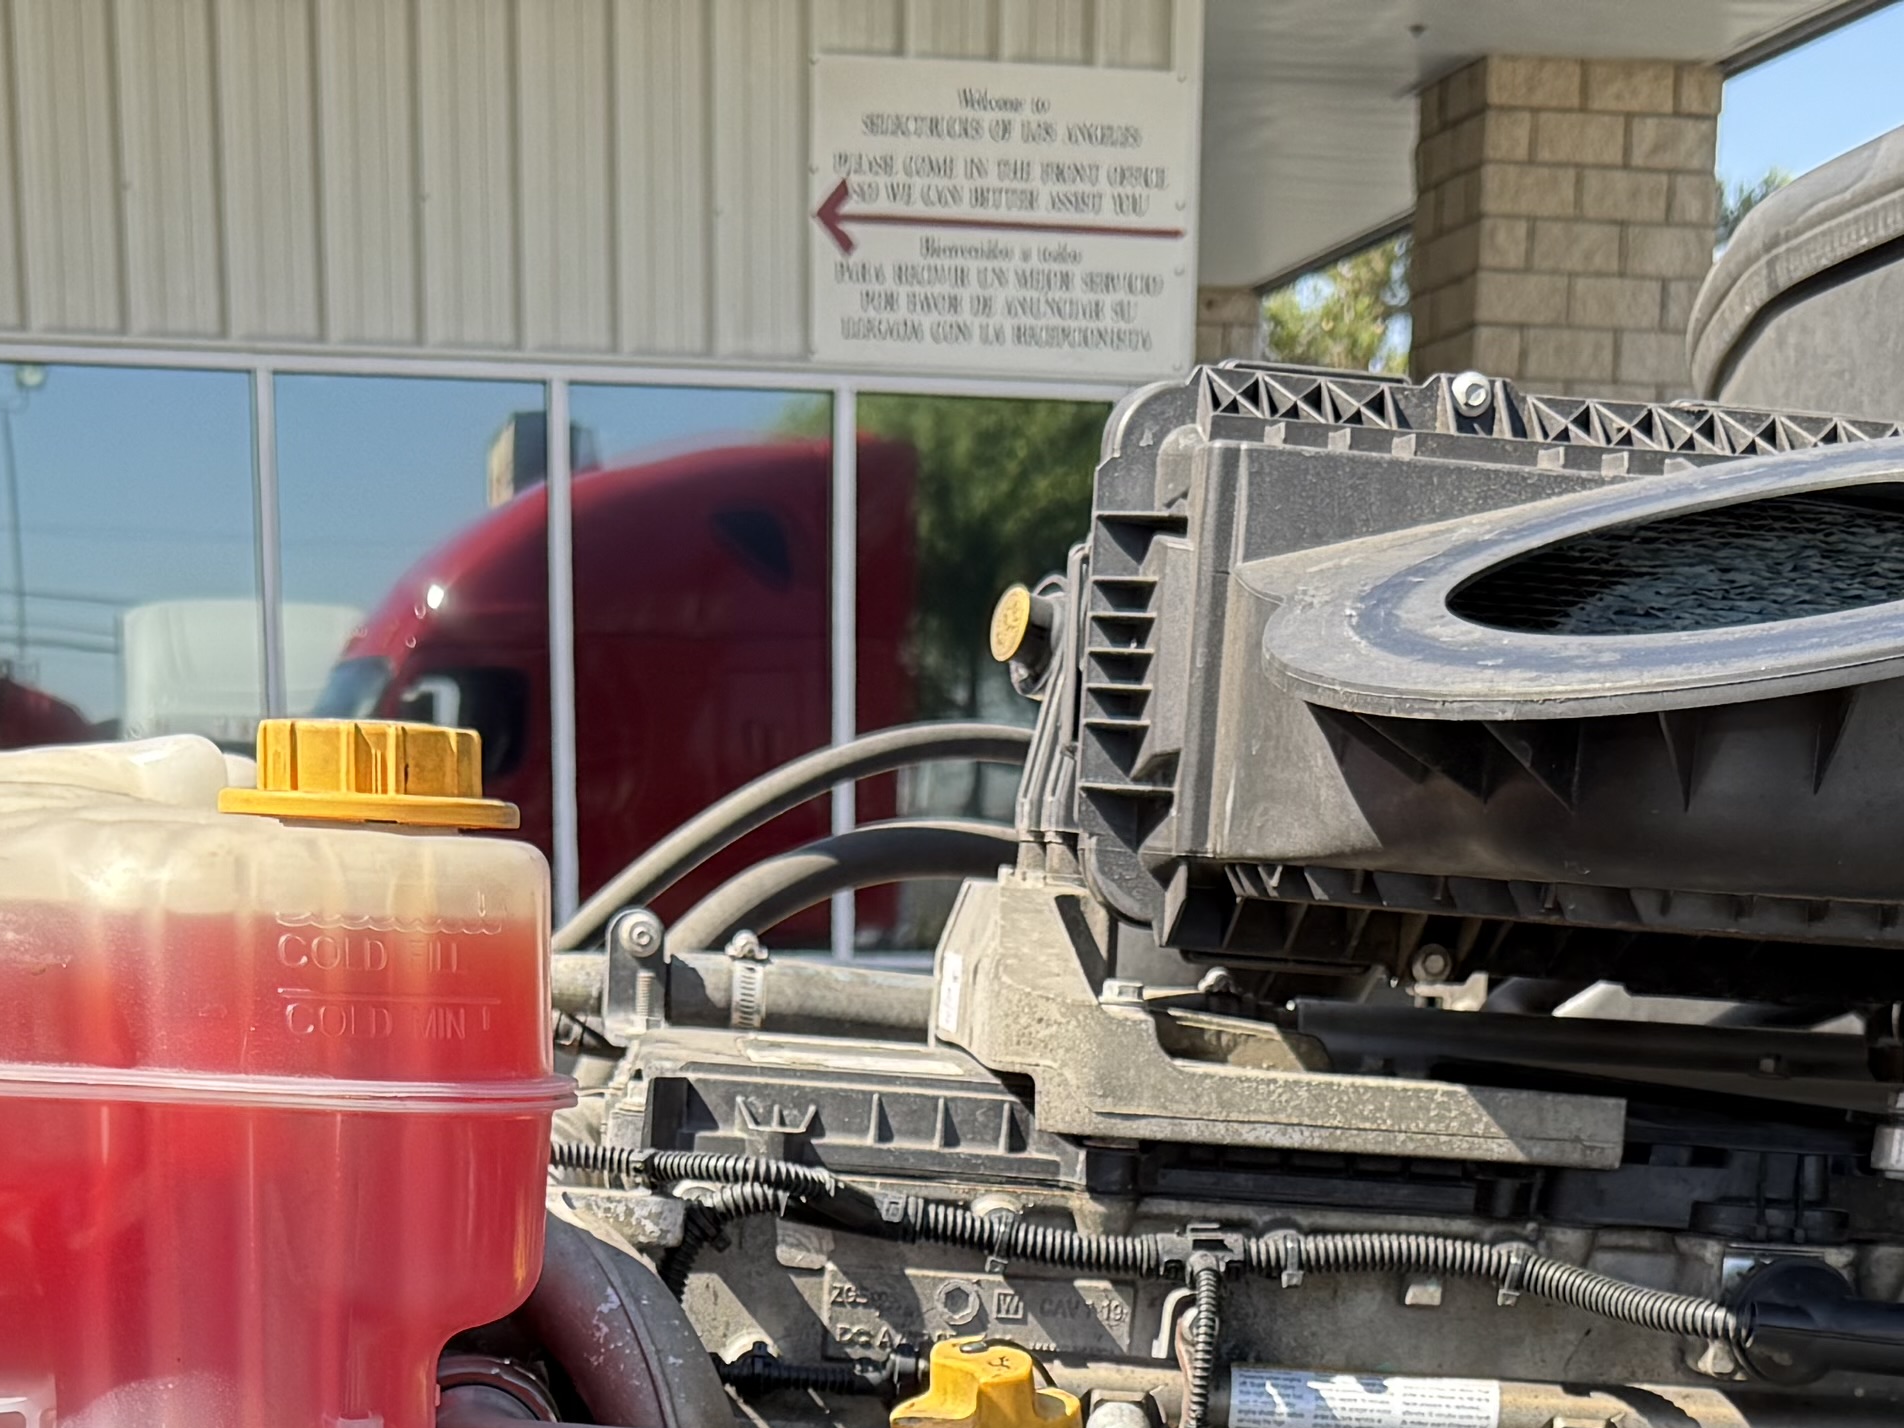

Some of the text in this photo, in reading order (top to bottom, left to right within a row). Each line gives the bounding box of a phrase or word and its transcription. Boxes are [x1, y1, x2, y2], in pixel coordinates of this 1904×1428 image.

[959, 88, 1050, 113] Welcome to
[862, 114, 1142, 148] SELECTRUCKS OF LOS ANGELES
[833, 152, 1169, 190] PLEASE COME IN THE FRONT OFFICE
[851, 180, 1149, 216] SO WE CAN BETTER ASSIST YOU
[834, 261, 1164, 296] PARA RECIBIR UN MEJOR SERVICIO
[860, 290, 1137, 324] POR FAVOR DE ANUNCIAR SU
[930, 320, 972, 344] CON
[979, 322, 1005, 345] LA
[277, 933, 465, 973] COLD FILL
[285, 1003, 466, 1040] COLD MIN
